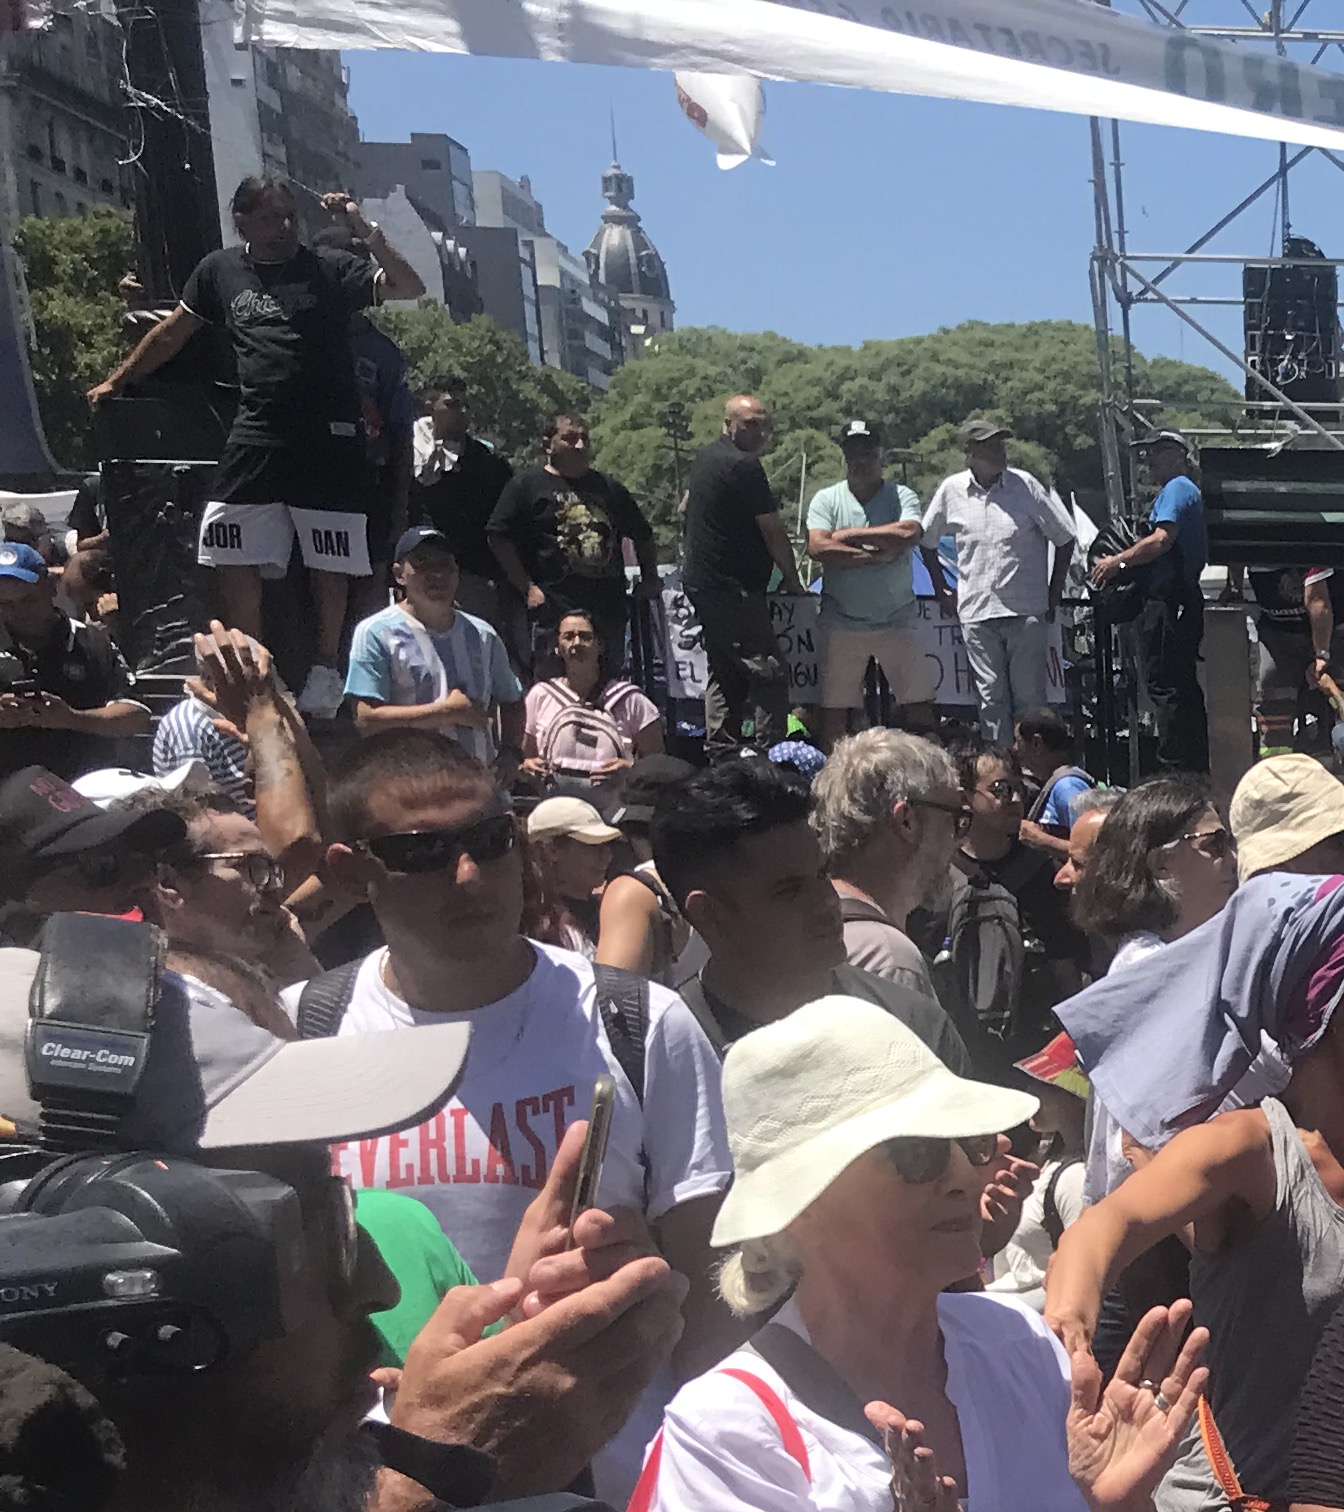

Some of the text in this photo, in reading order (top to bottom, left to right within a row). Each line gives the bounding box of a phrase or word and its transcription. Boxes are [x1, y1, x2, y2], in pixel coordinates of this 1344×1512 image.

[202, 522, 351, 557] JOR DAN
[41, 1042, 136, 1067] Clear-Com
[0, 1281, 58, 1301] ONY
